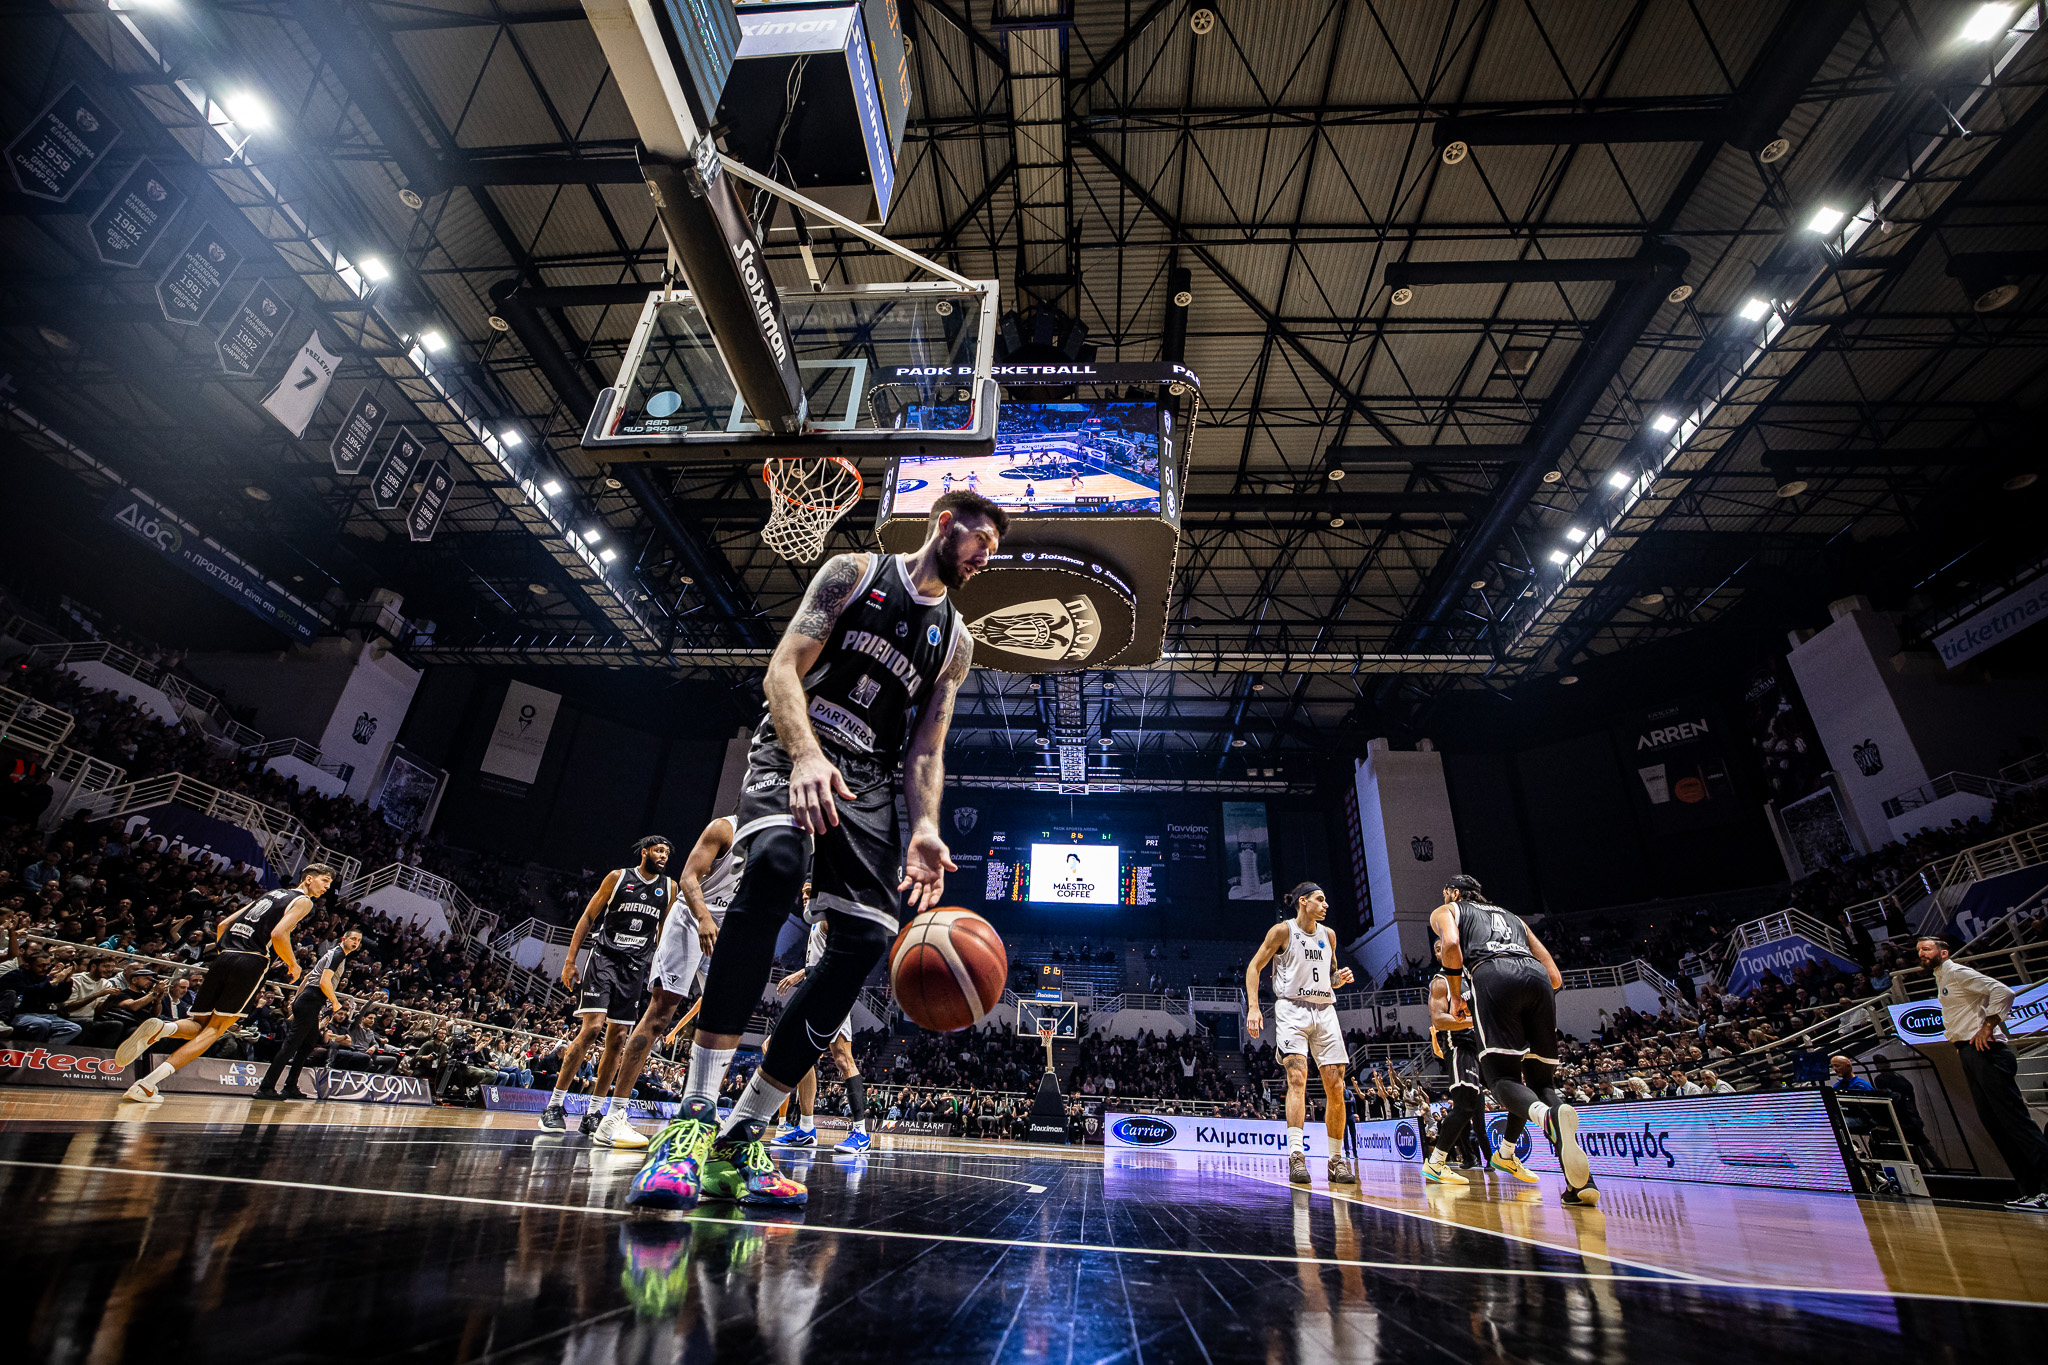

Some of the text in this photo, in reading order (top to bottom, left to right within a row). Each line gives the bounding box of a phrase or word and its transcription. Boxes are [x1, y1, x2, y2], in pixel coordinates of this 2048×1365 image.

[851, 25, 888, 185] Stoiximan
[30, 156, 58, 180] GREEK
[37, 140, 71, 172] 1959
[16, 154, 60, 193] CHAMPION
[113, 212, 143, 240] 1984
[107, 228, 131, 250] GREEK
[107, 237, 122, 250] CUP
[168, 283, 199, 312] EUROPEAN
[179, 274, 203, 299] 1991
[173, 296, 186, 308] CUP
[733, 239, 787, 365] Stoiximan
[236, 329, 258, 352] 1992
[222, 343, 250, 370] CHAMPION
[305, 347, 333, 377] PRELEVIC
[293, 365, 319, 392] 7
[896, 366, 952, 376] PAOK
[345, 432, 362, 452] 1994
[384, 471, 400, 489] 1995
[115, 503, 174, 551] Διός
[1038, 553, 1085, 566] Stoiximan
[192, 553, 245, 592] ΠΡΟΣΤΑΣΙΑ
[244, 587, 262, 606] είναι
[262, 600, 276, 614] στη
[298, 624, 312, 637] του
[841, 630, 923, 698] PRIEVIDZA
[847, 673, 882, 709] 25
[815, 703, 873, 746] PARTNERS
[1637, 717, 1710, 751] ARREN
[1145, 839, 1159, 847] PRI
[1053, 883, 1095, 891] MAESTRO
[1057, 890, 1091, 899] COFFEE
[617, 902, 661, 920] PRIEVIDZA
[1490, 912, 1513, 941] 4
[1304, 949, 1324, 961] PAOK
[1312, 967, 1320, 983] 6
[62, 1072, 97, 1080] AIMING
[327, 1069, 422, 1096] FARCOM
[899, 1121, 920, 1129] ARAL
[923, 1122, 944, 1130] FARM
[1030, 1123, 1063, 1133] Stoiximan
[1121, 1122, 1167, 1138] Carrier
[1194, 1126, 1308, 1151] Κλιματισμς
